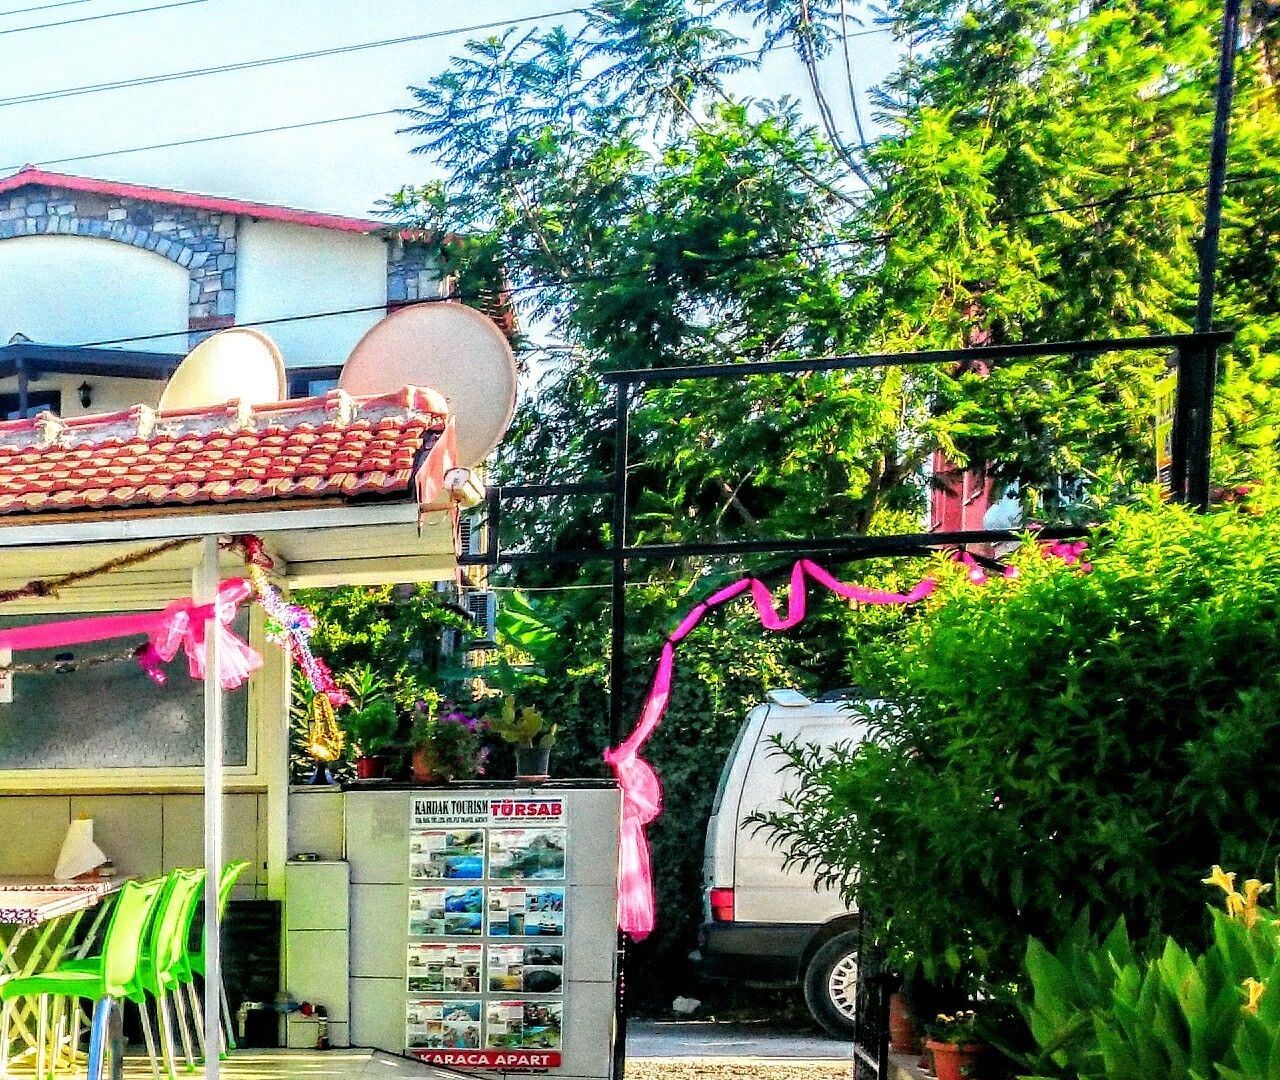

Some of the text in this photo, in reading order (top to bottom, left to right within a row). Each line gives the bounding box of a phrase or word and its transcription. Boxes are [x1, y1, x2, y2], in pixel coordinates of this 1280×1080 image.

[415, 800, 488, 815] KARDAK TOURISM
[491, 800, 562, 816] TÜRSAB
[420, 1054, 550, 1065] KARACA APART
